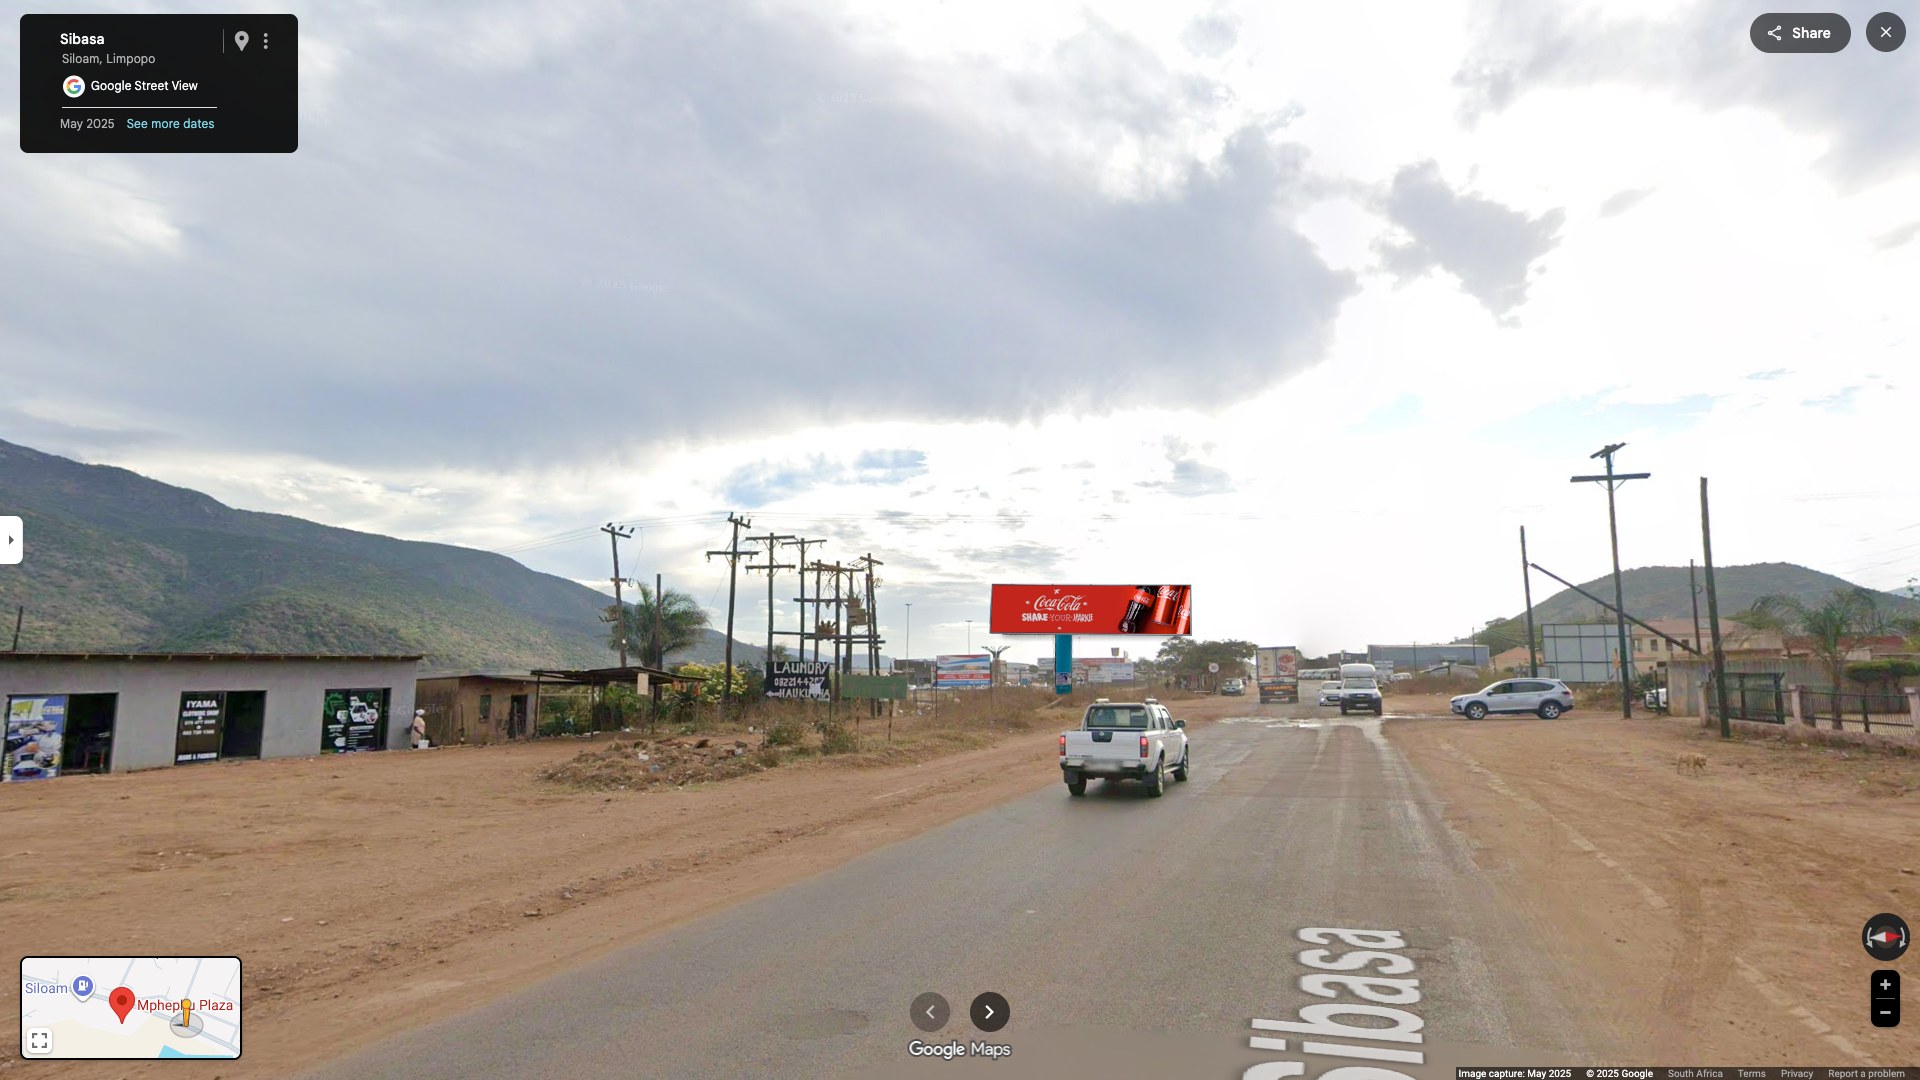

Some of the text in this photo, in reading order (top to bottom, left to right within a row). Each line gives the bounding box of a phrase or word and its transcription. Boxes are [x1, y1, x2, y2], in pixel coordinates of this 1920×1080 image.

[1033, 595, 1085, 612] Coca-Cola
[1021, 612, 1049, 622] SHARE
[773, 661, 830, 675] LAUNDRY
[186, 700, 217, 708] IYAMA
